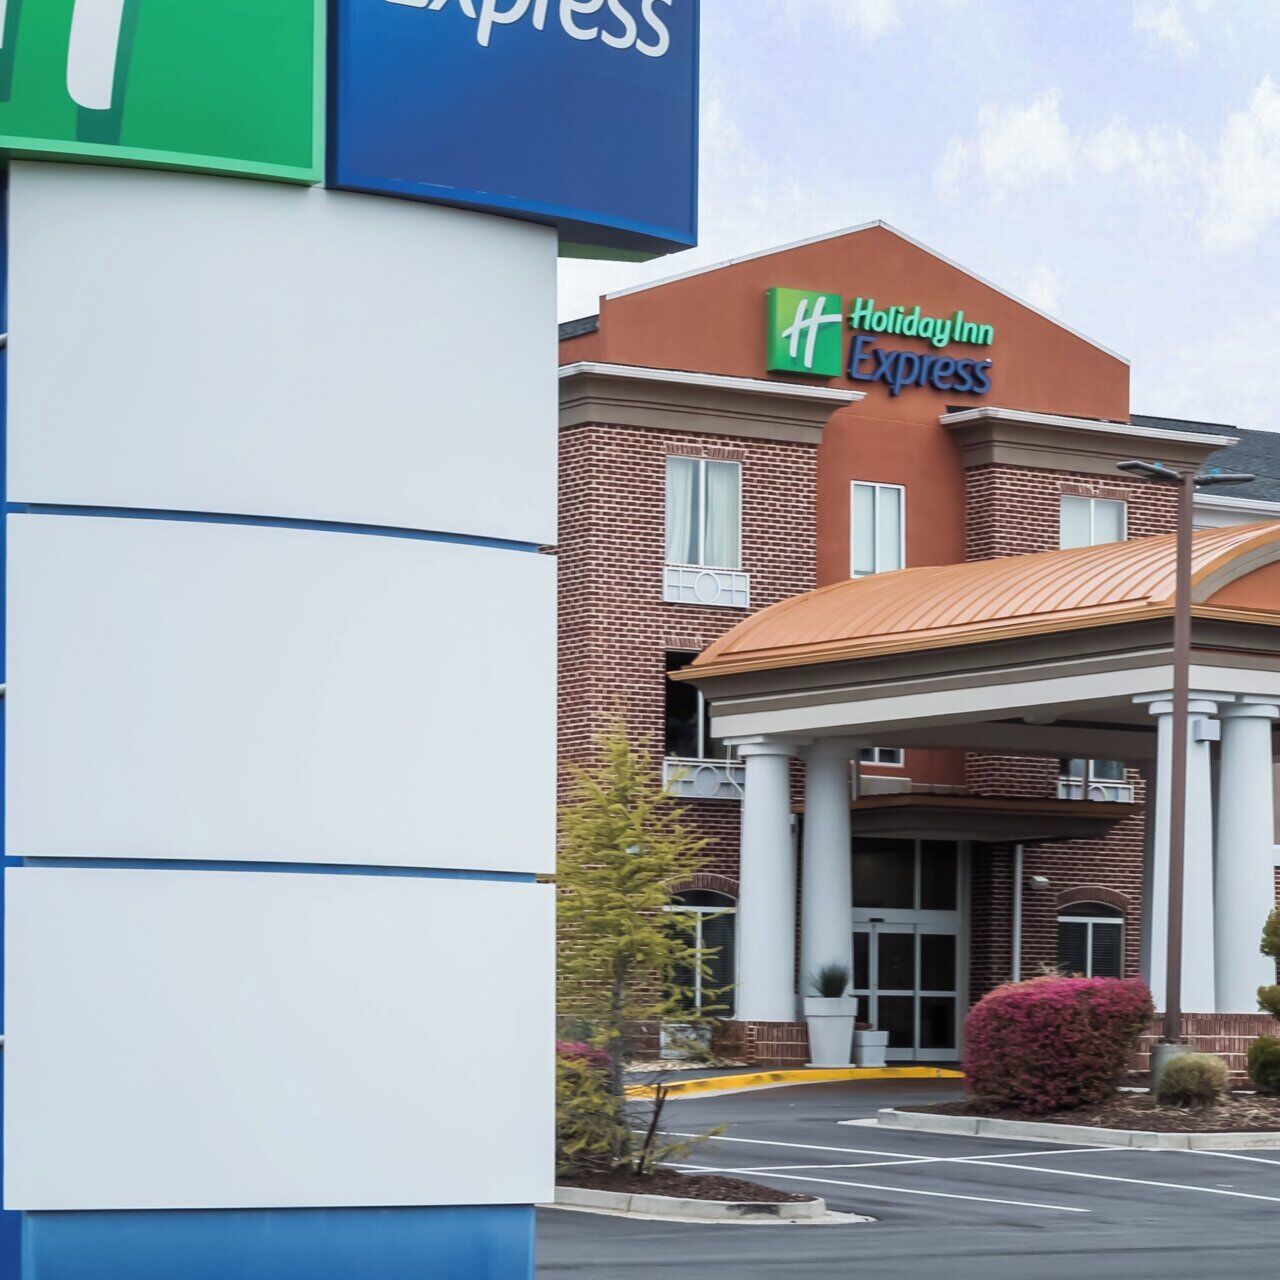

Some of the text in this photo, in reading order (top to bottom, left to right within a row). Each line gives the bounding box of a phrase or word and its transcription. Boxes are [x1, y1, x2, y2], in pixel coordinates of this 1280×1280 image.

[851, 297, 994, 347] Holiday Inn
[849, 335, 992, 396] Express
